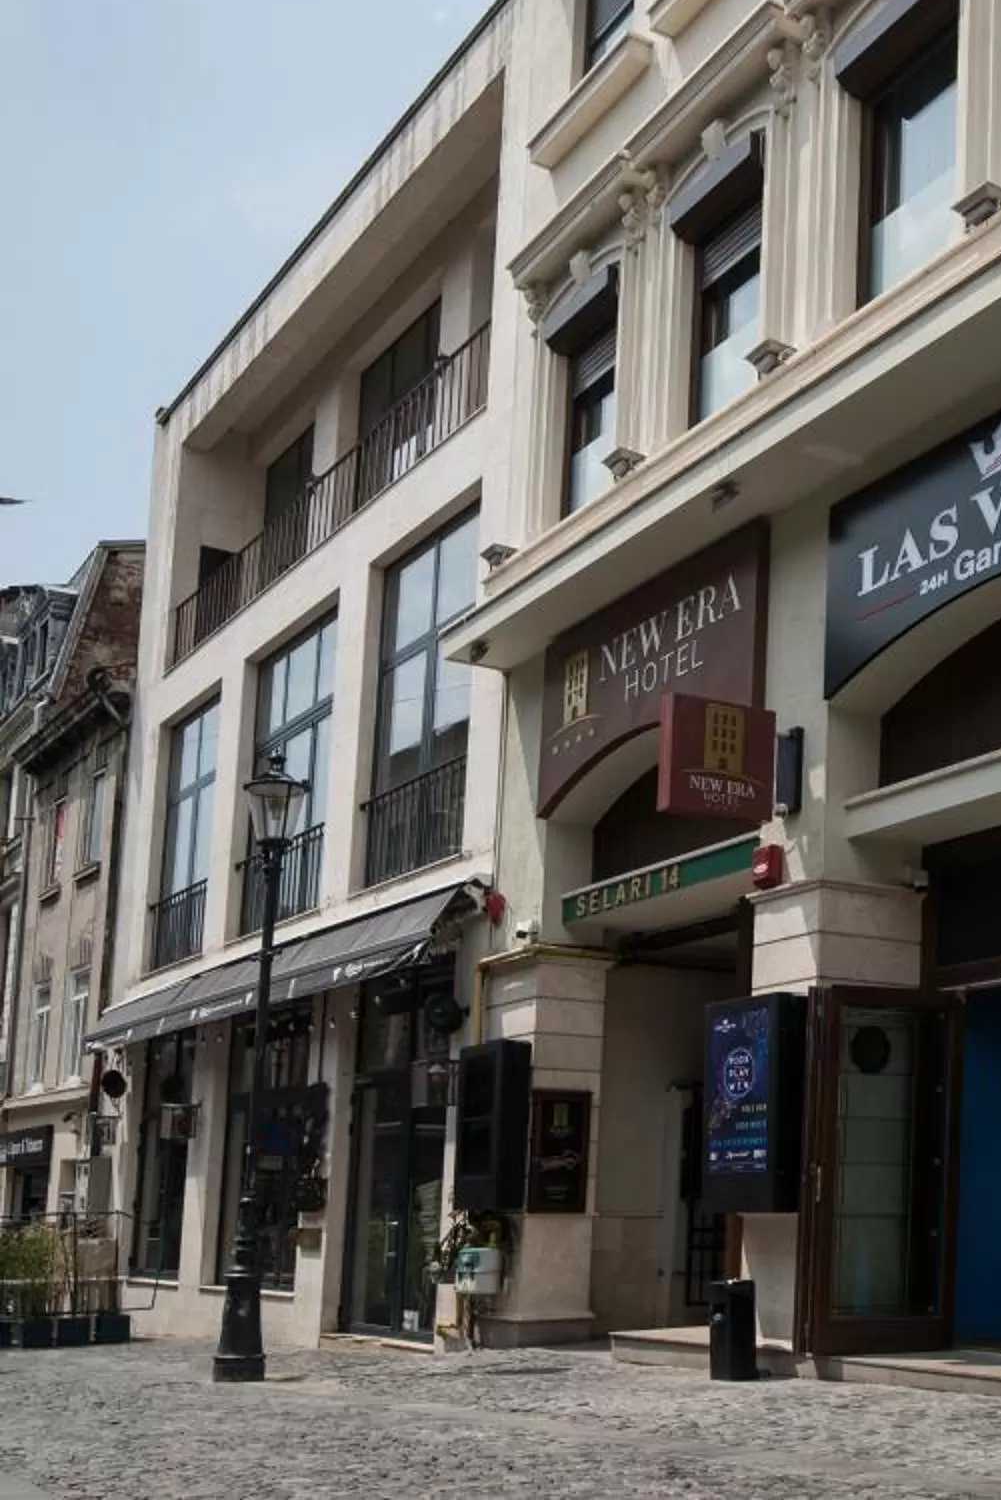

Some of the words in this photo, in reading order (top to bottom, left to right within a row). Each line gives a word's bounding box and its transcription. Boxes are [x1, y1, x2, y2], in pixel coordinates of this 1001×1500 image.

[857, 503, 959, 597] LAS
[919, 570, 949, 596] 24H
[599, 611, 668, 682] NEW
[674, 572, 743, 643] ERA
[623, 639, 704, 702] HOTEL
[689, 774, 724, 793] NEW
[576, 873, 651, 917] SELARI
[662, 864, 679, 892] 14
